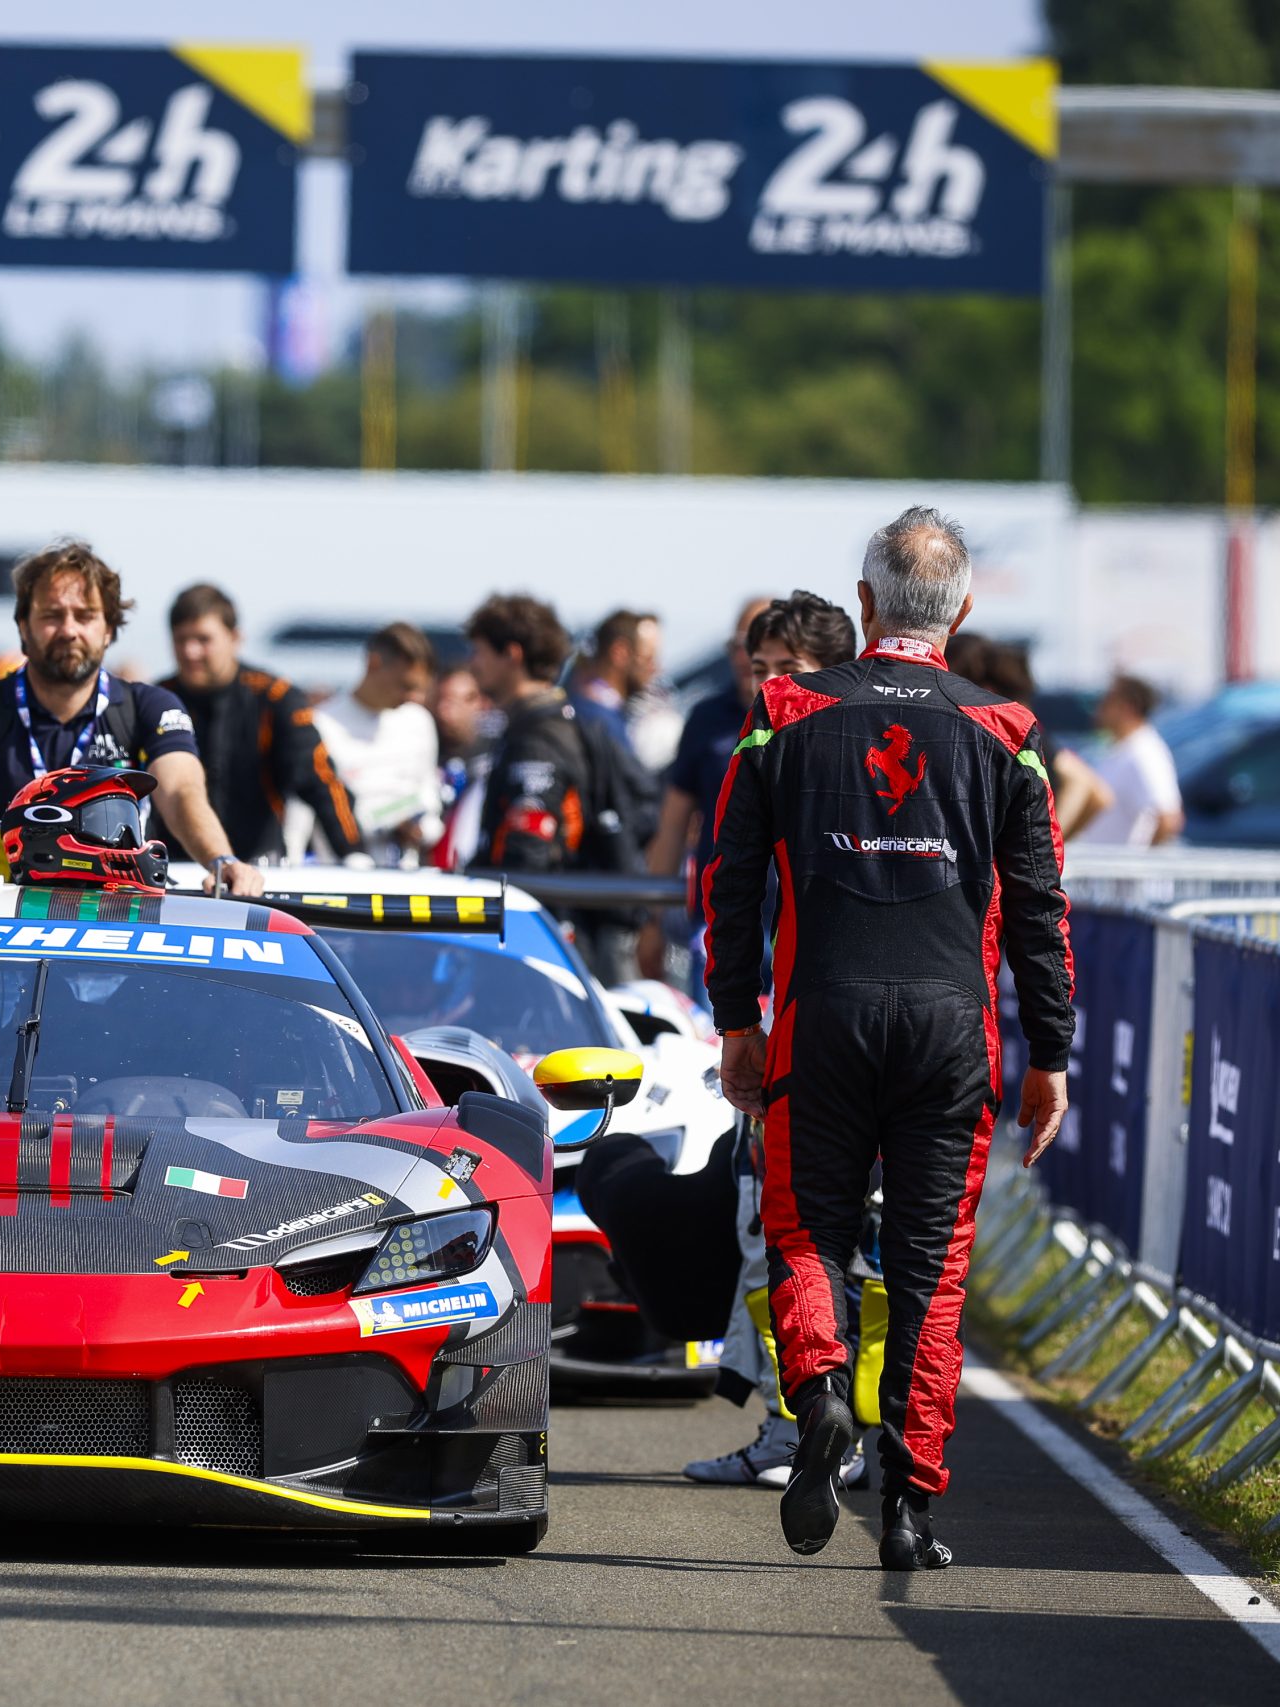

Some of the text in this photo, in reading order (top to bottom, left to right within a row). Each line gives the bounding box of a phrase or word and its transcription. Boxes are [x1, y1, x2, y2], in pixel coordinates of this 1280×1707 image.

[410, 117, 741, 221] Karting
[4, 200, 226, 240] LE MANS
[751, 217, 972, 256] LE MANS
[883, 686, 933, 699] FLY7
[402, 1292, 488, 1319] MICHELIN
